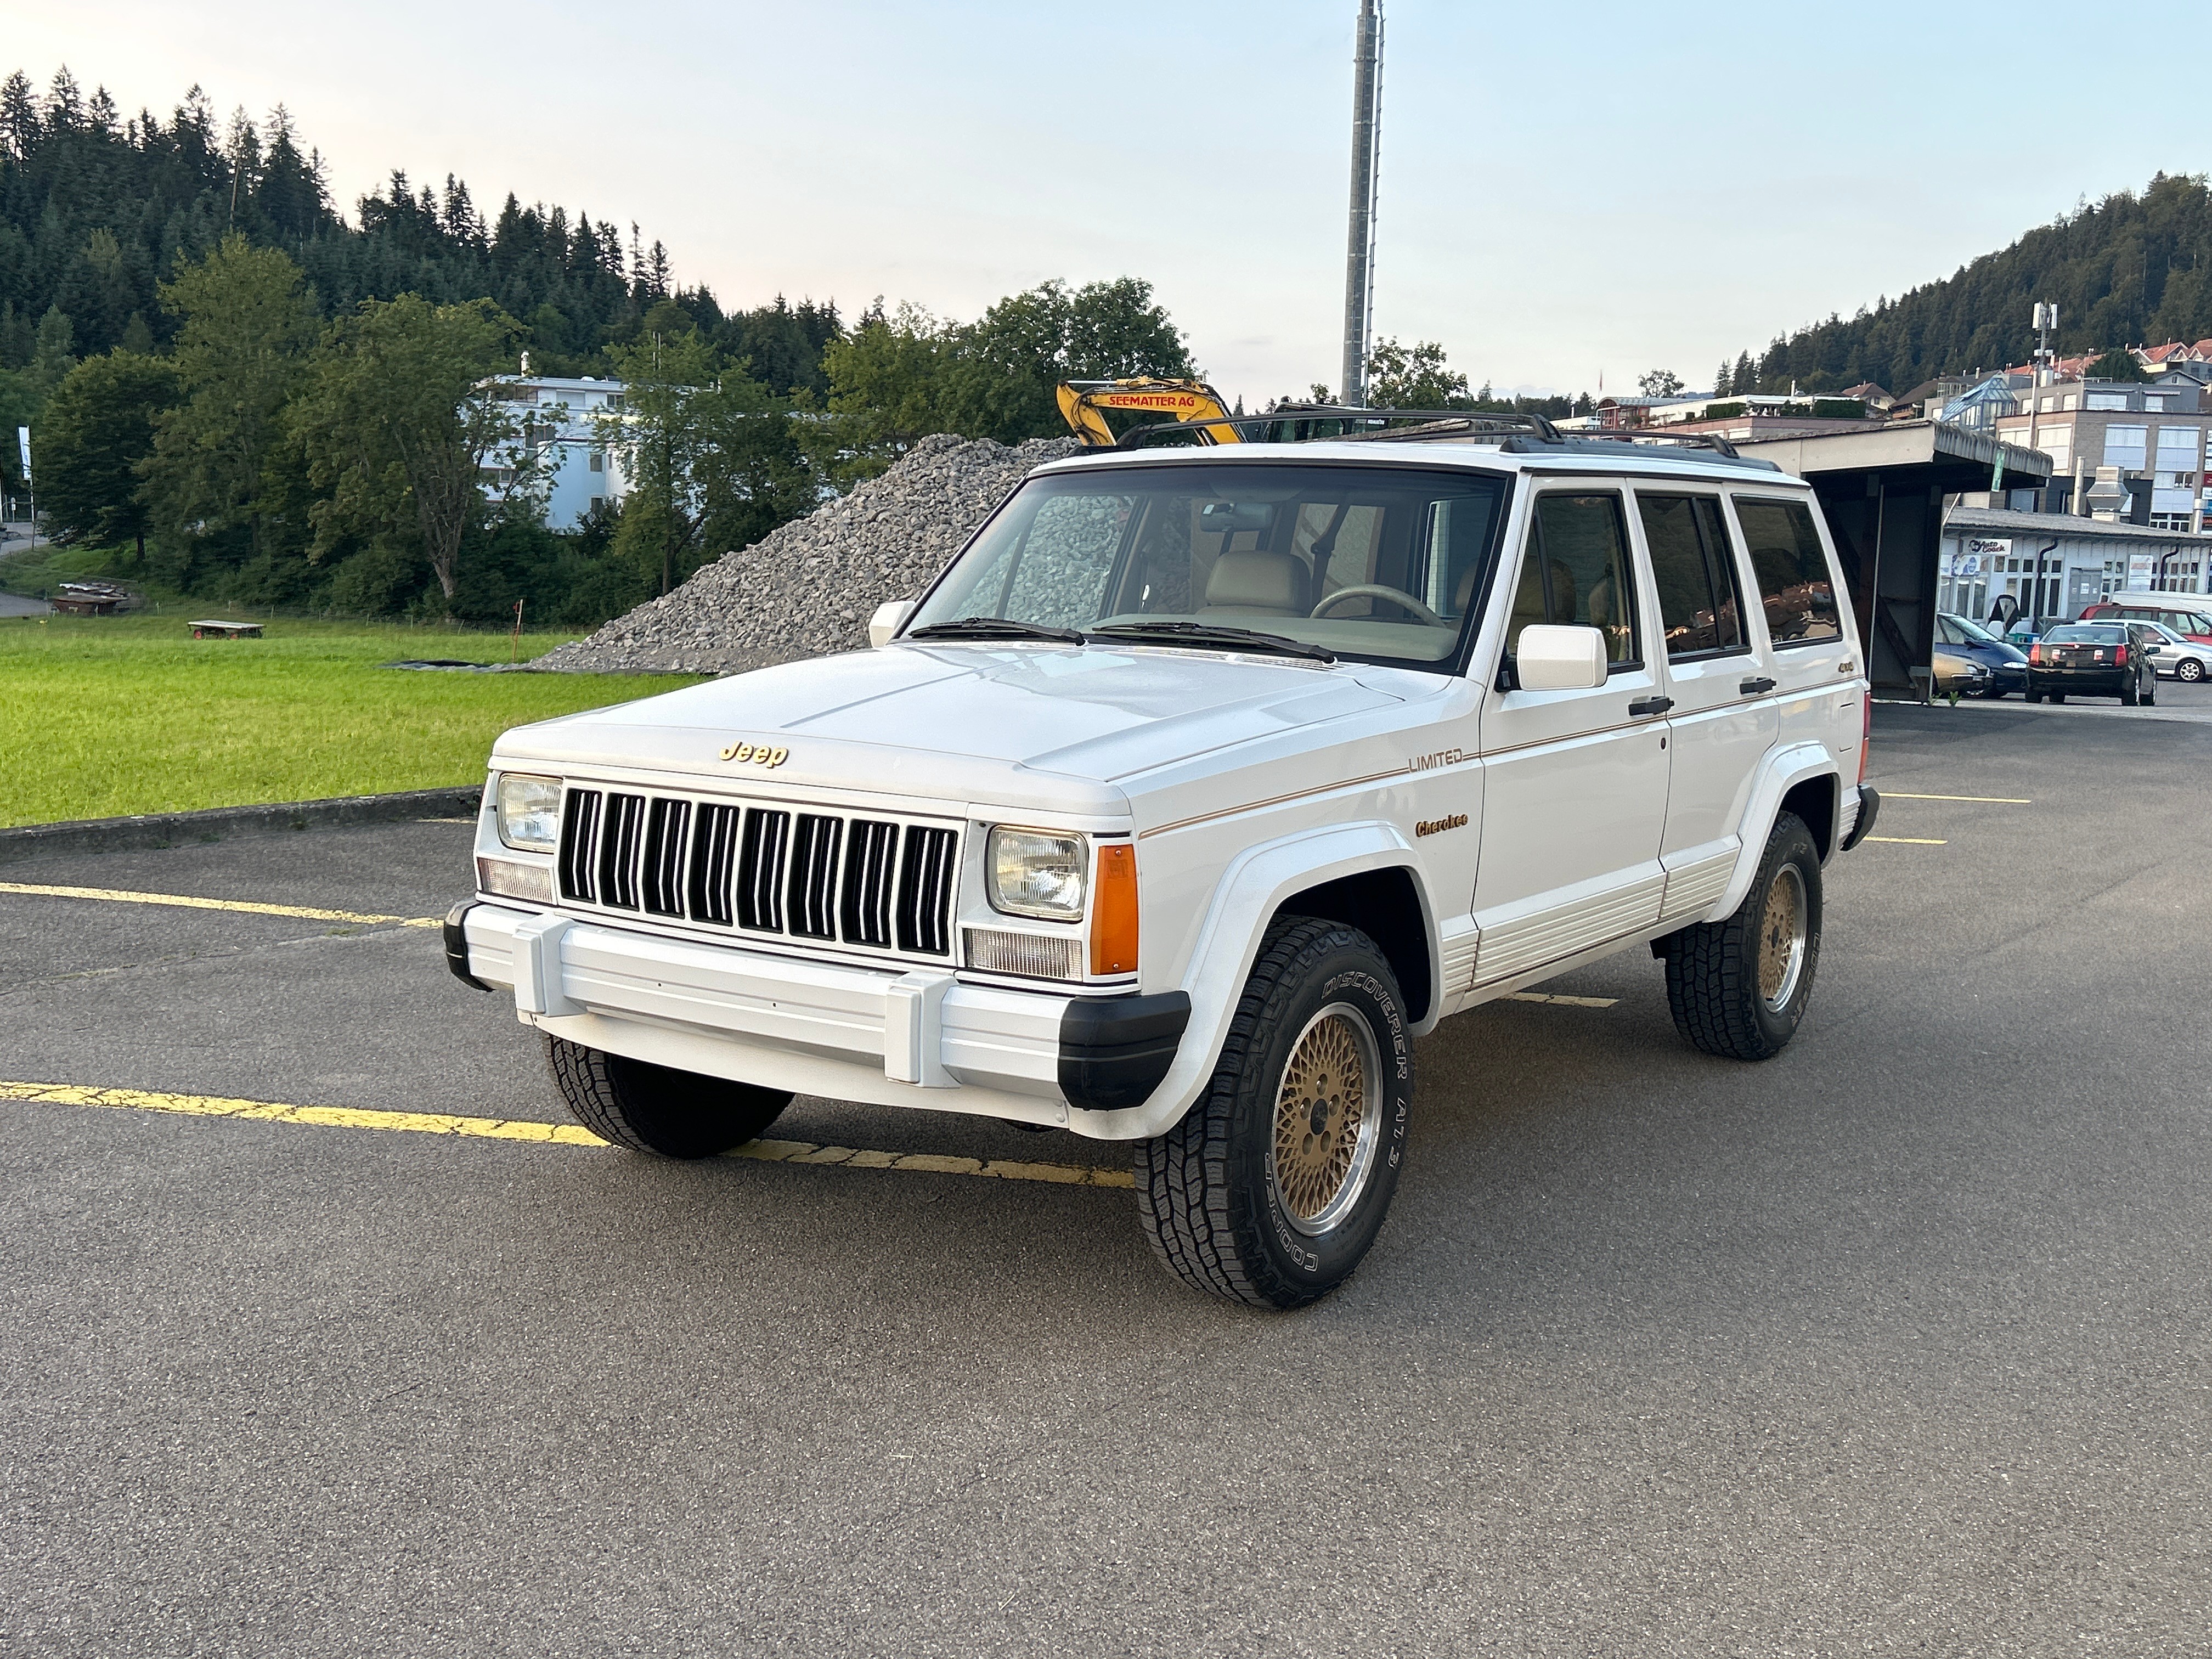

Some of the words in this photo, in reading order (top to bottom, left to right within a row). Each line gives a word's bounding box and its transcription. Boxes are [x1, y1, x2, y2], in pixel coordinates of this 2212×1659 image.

[1109, 396, 1176, 407] SEEMATTER
[1178, 396, 1195, 407] AG
[718, 740, 789, 769] Jeep
[1408, 748, 1463, 773] LIMITED
[1415, 814, 1469, 838] Cherokee
[1321, 971, 1408, 1080] DISCOVERER
